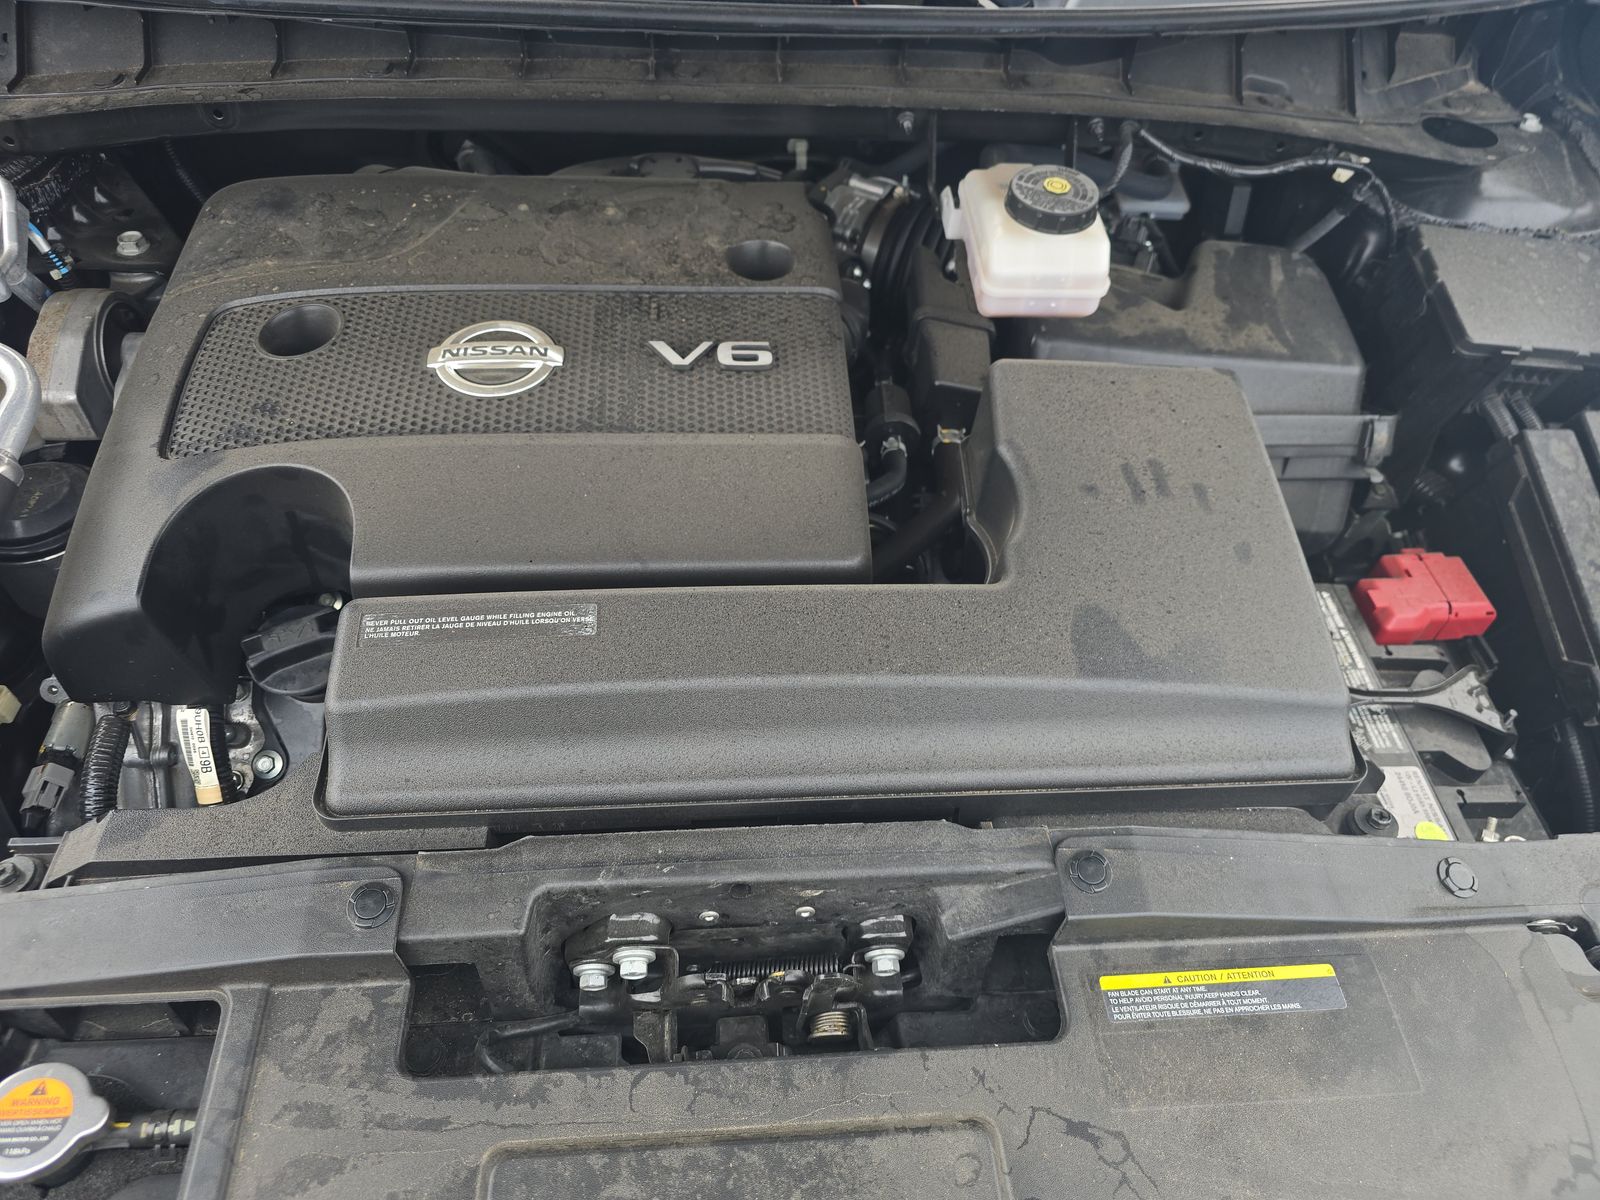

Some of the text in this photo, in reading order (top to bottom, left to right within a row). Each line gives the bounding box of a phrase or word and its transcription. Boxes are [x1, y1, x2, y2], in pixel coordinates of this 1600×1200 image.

[441, 346, 549, 358] NISSAN
[648, 341, 773, 371] V6
[200, 760, 212, 773] 9B
[1177, 974, 1216, 983] CAUTION
[1227, 971, 1274, 980] ATTENTION
[1120, 1004, 1157, 1012] VENTILATEUR
[1190, 1000, 1221, 1008] DÉMARRER
[1132, 1011, 1151, 1019] ÉVITER
[12, 1096, 60, 1106] WARNING
